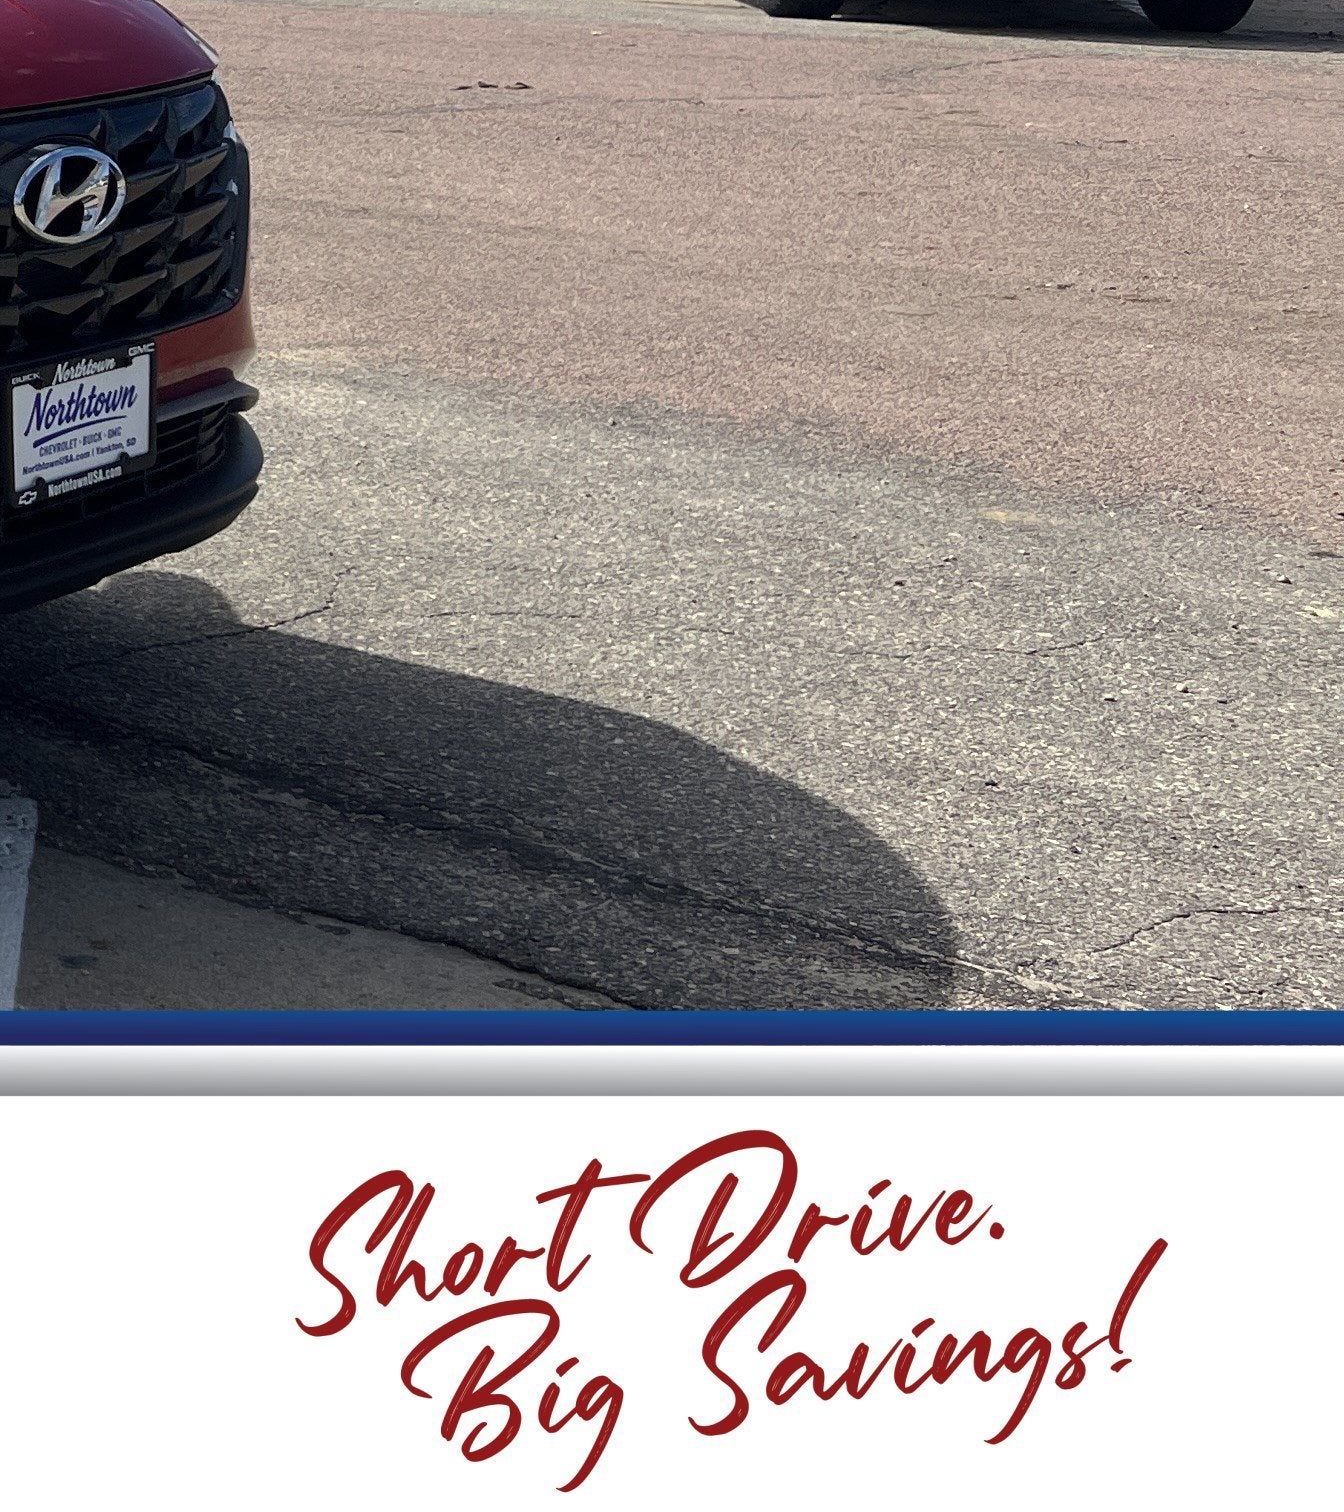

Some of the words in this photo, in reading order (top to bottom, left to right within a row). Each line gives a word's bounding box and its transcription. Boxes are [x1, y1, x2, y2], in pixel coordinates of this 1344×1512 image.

[128, 342, 155, 357] GMC
[12, 373, 41, 385] BUICK
[52, 357, 116, 386] Northtown
[24, 383, 138, 437] Northtown
[23, 450, 91, 475] NorthtownUSA.com
[126, 436, 137, 448] SD
[39, 437, 77, 457] CHEVROLET
[83, 431, 103, 446] BUICK
[107, 426, 122, 439] GMC
[48, 465, 122, 497] NorthtownUSA.com
